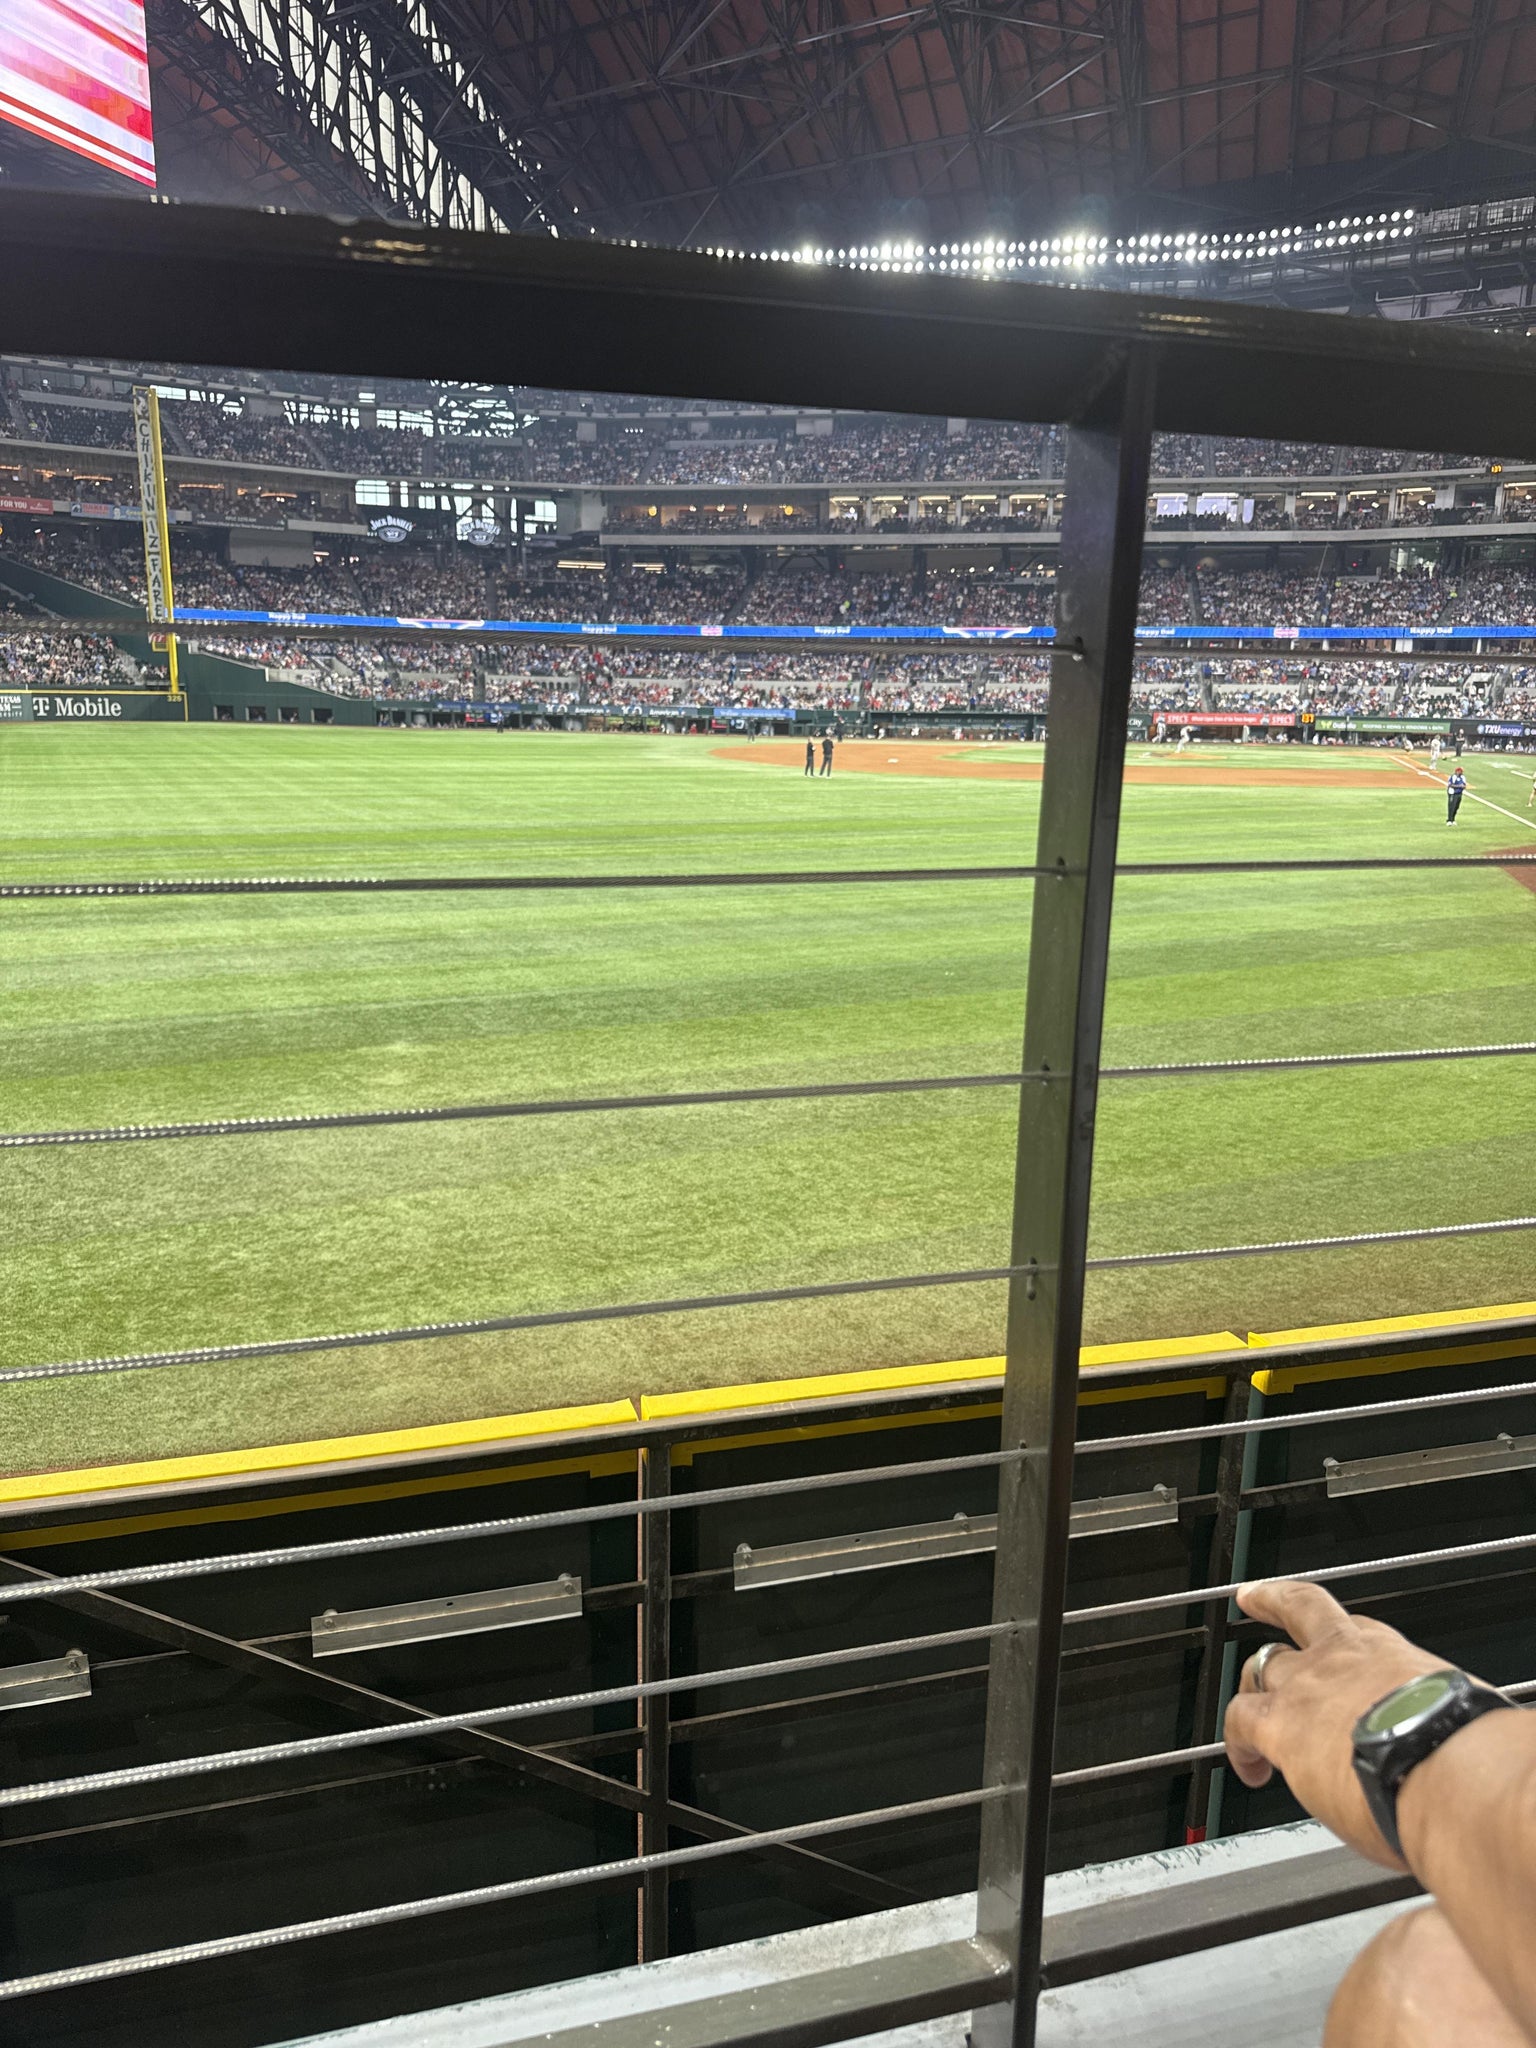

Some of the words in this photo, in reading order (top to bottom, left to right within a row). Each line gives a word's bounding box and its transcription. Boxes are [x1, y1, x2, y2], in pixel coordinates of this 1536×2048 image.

[15, 501, 27, 509] YOU
[151, 558, 163, 617] FARE
[815, 626, 836, 635] Happy
[1410, 627, 1436, 635] Happy
[33, 697, 50, 716] T
[55, 697, 122, 717] Mobile
